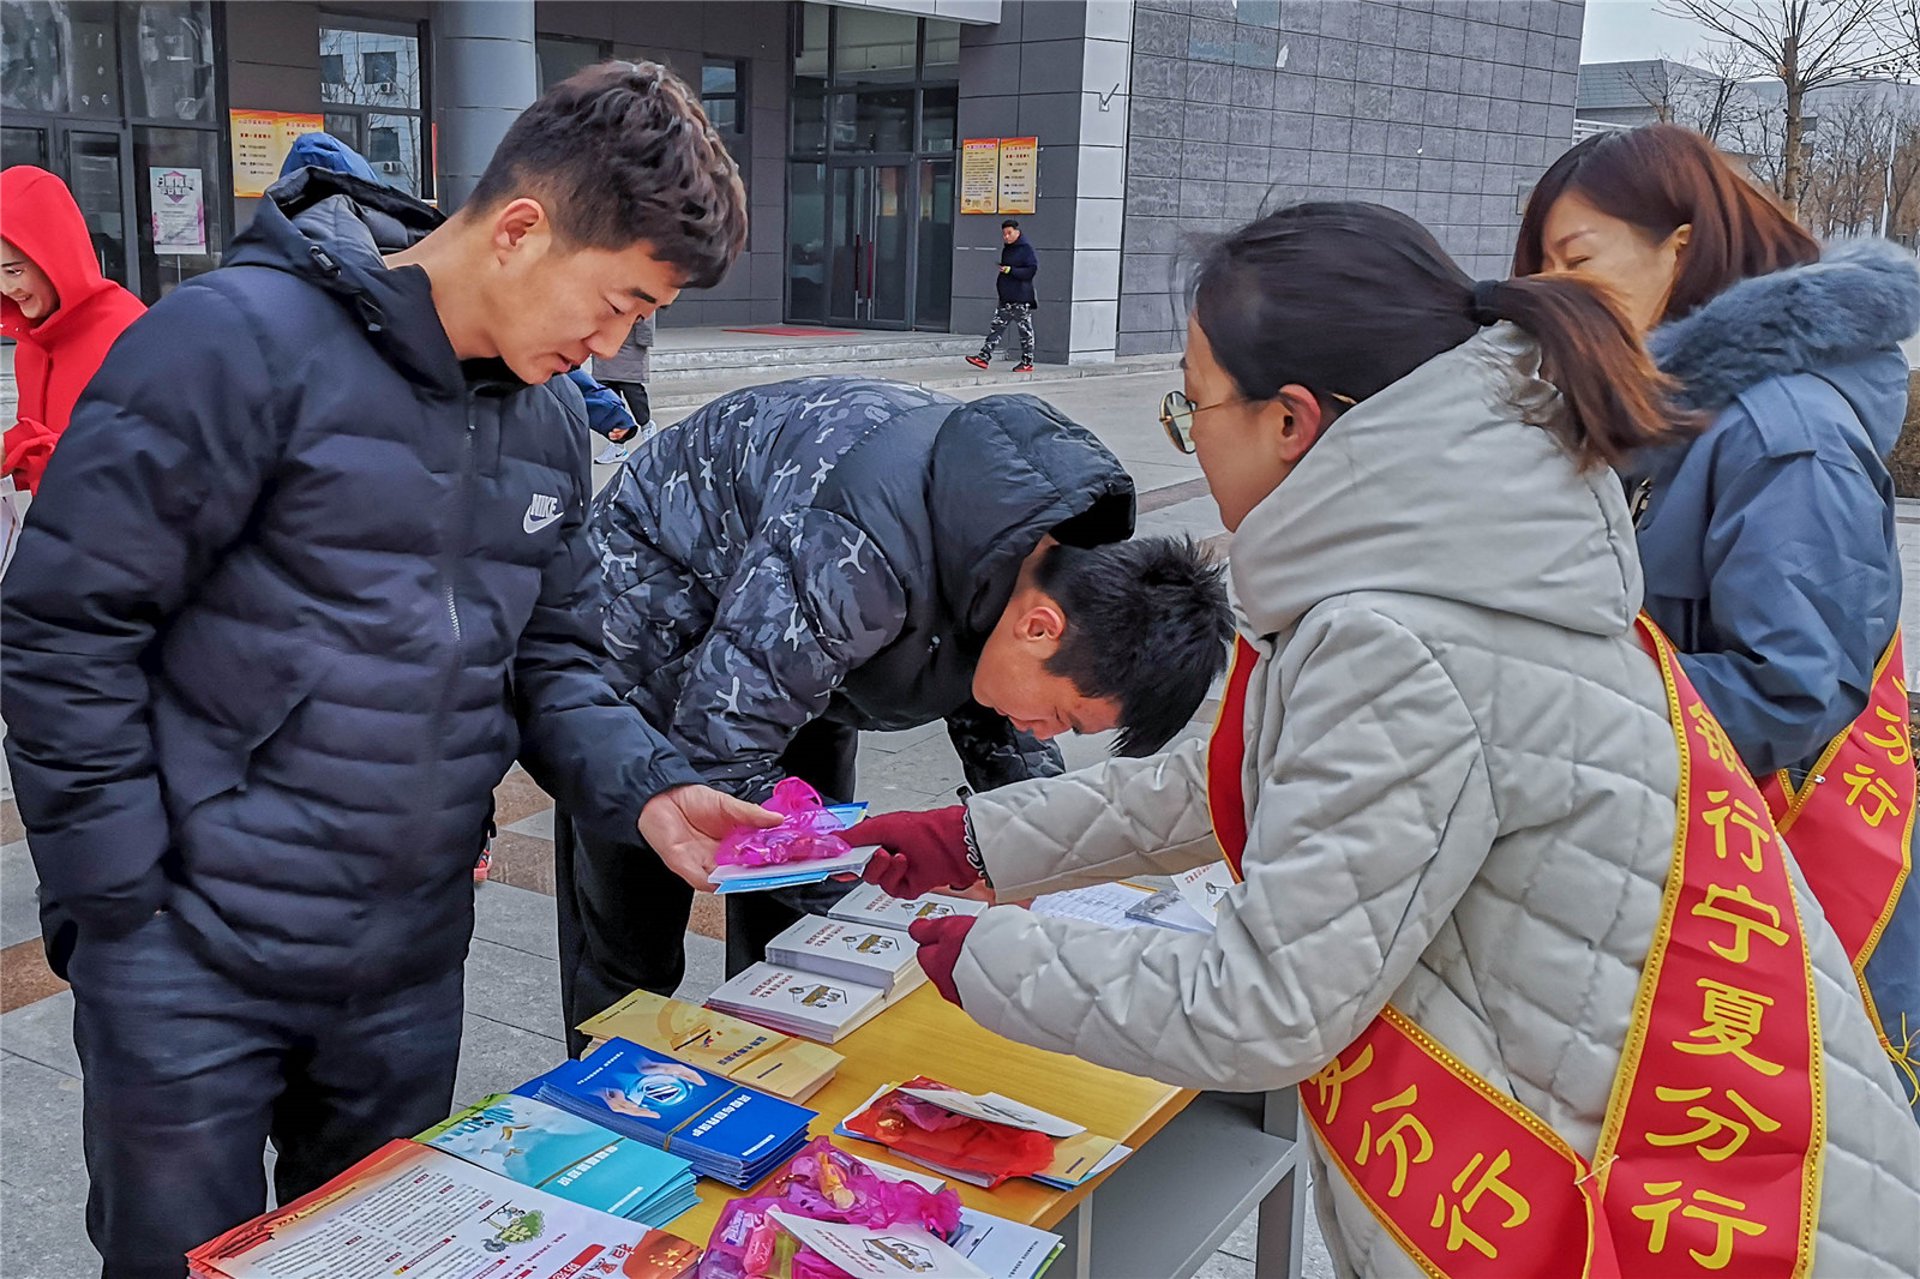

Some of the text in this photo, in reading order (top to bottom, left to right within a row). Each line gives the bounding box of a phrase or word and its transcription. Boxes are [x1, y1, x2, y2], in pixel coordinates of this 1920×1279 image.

[530, 493, 558, 517] NIKE
[1843, 675, 1913, 827] 分行
[1631, 701, 1789, 1270] 银行宁夏分行
